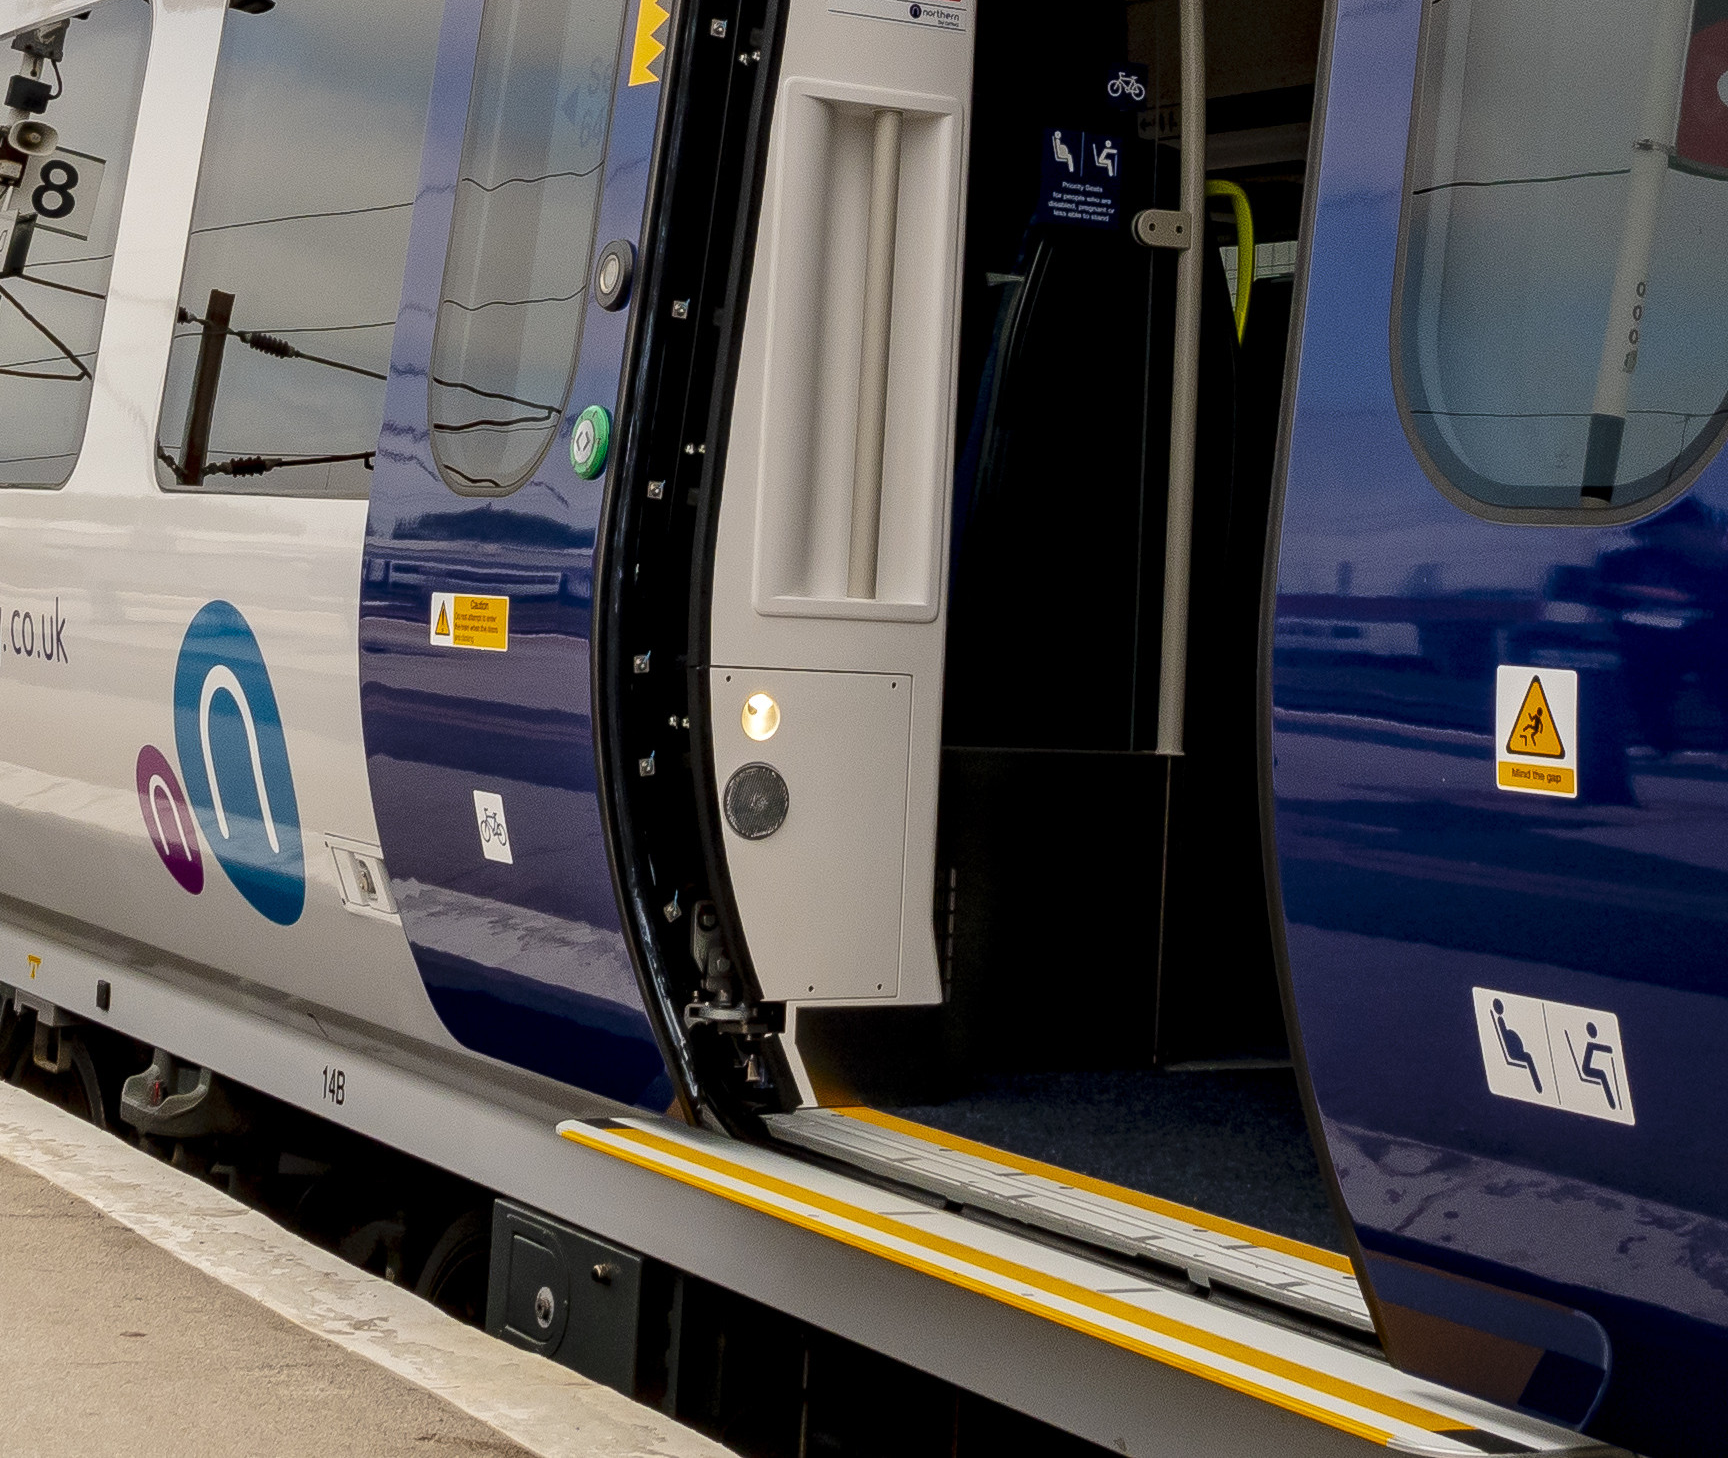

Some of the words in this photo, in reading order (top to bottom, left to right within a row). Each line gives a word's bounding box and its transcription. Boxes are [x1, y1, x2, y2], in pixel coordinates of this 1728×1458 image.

[922, 9, 960, 21] northern
[1062, 181, 1084, 191] Priority
[1085, 184, 1103, 193] Seats
[1048, 200, 1077, 210] disabled,
[1078, 204, 1107, 213] pregnant
[1053, 209, 1067, 217] less
[1067, 211, 1082, 219] able
[1090, 214, 1110, 222] stand
[470, 599, 490, 611] Caution
[1511, 768, 1531, 780] Mind
[1532, 770, 1545, 781] the
[1546, 773, 1562, 784] gap
[323, 1065, 346, 1106] 14B
